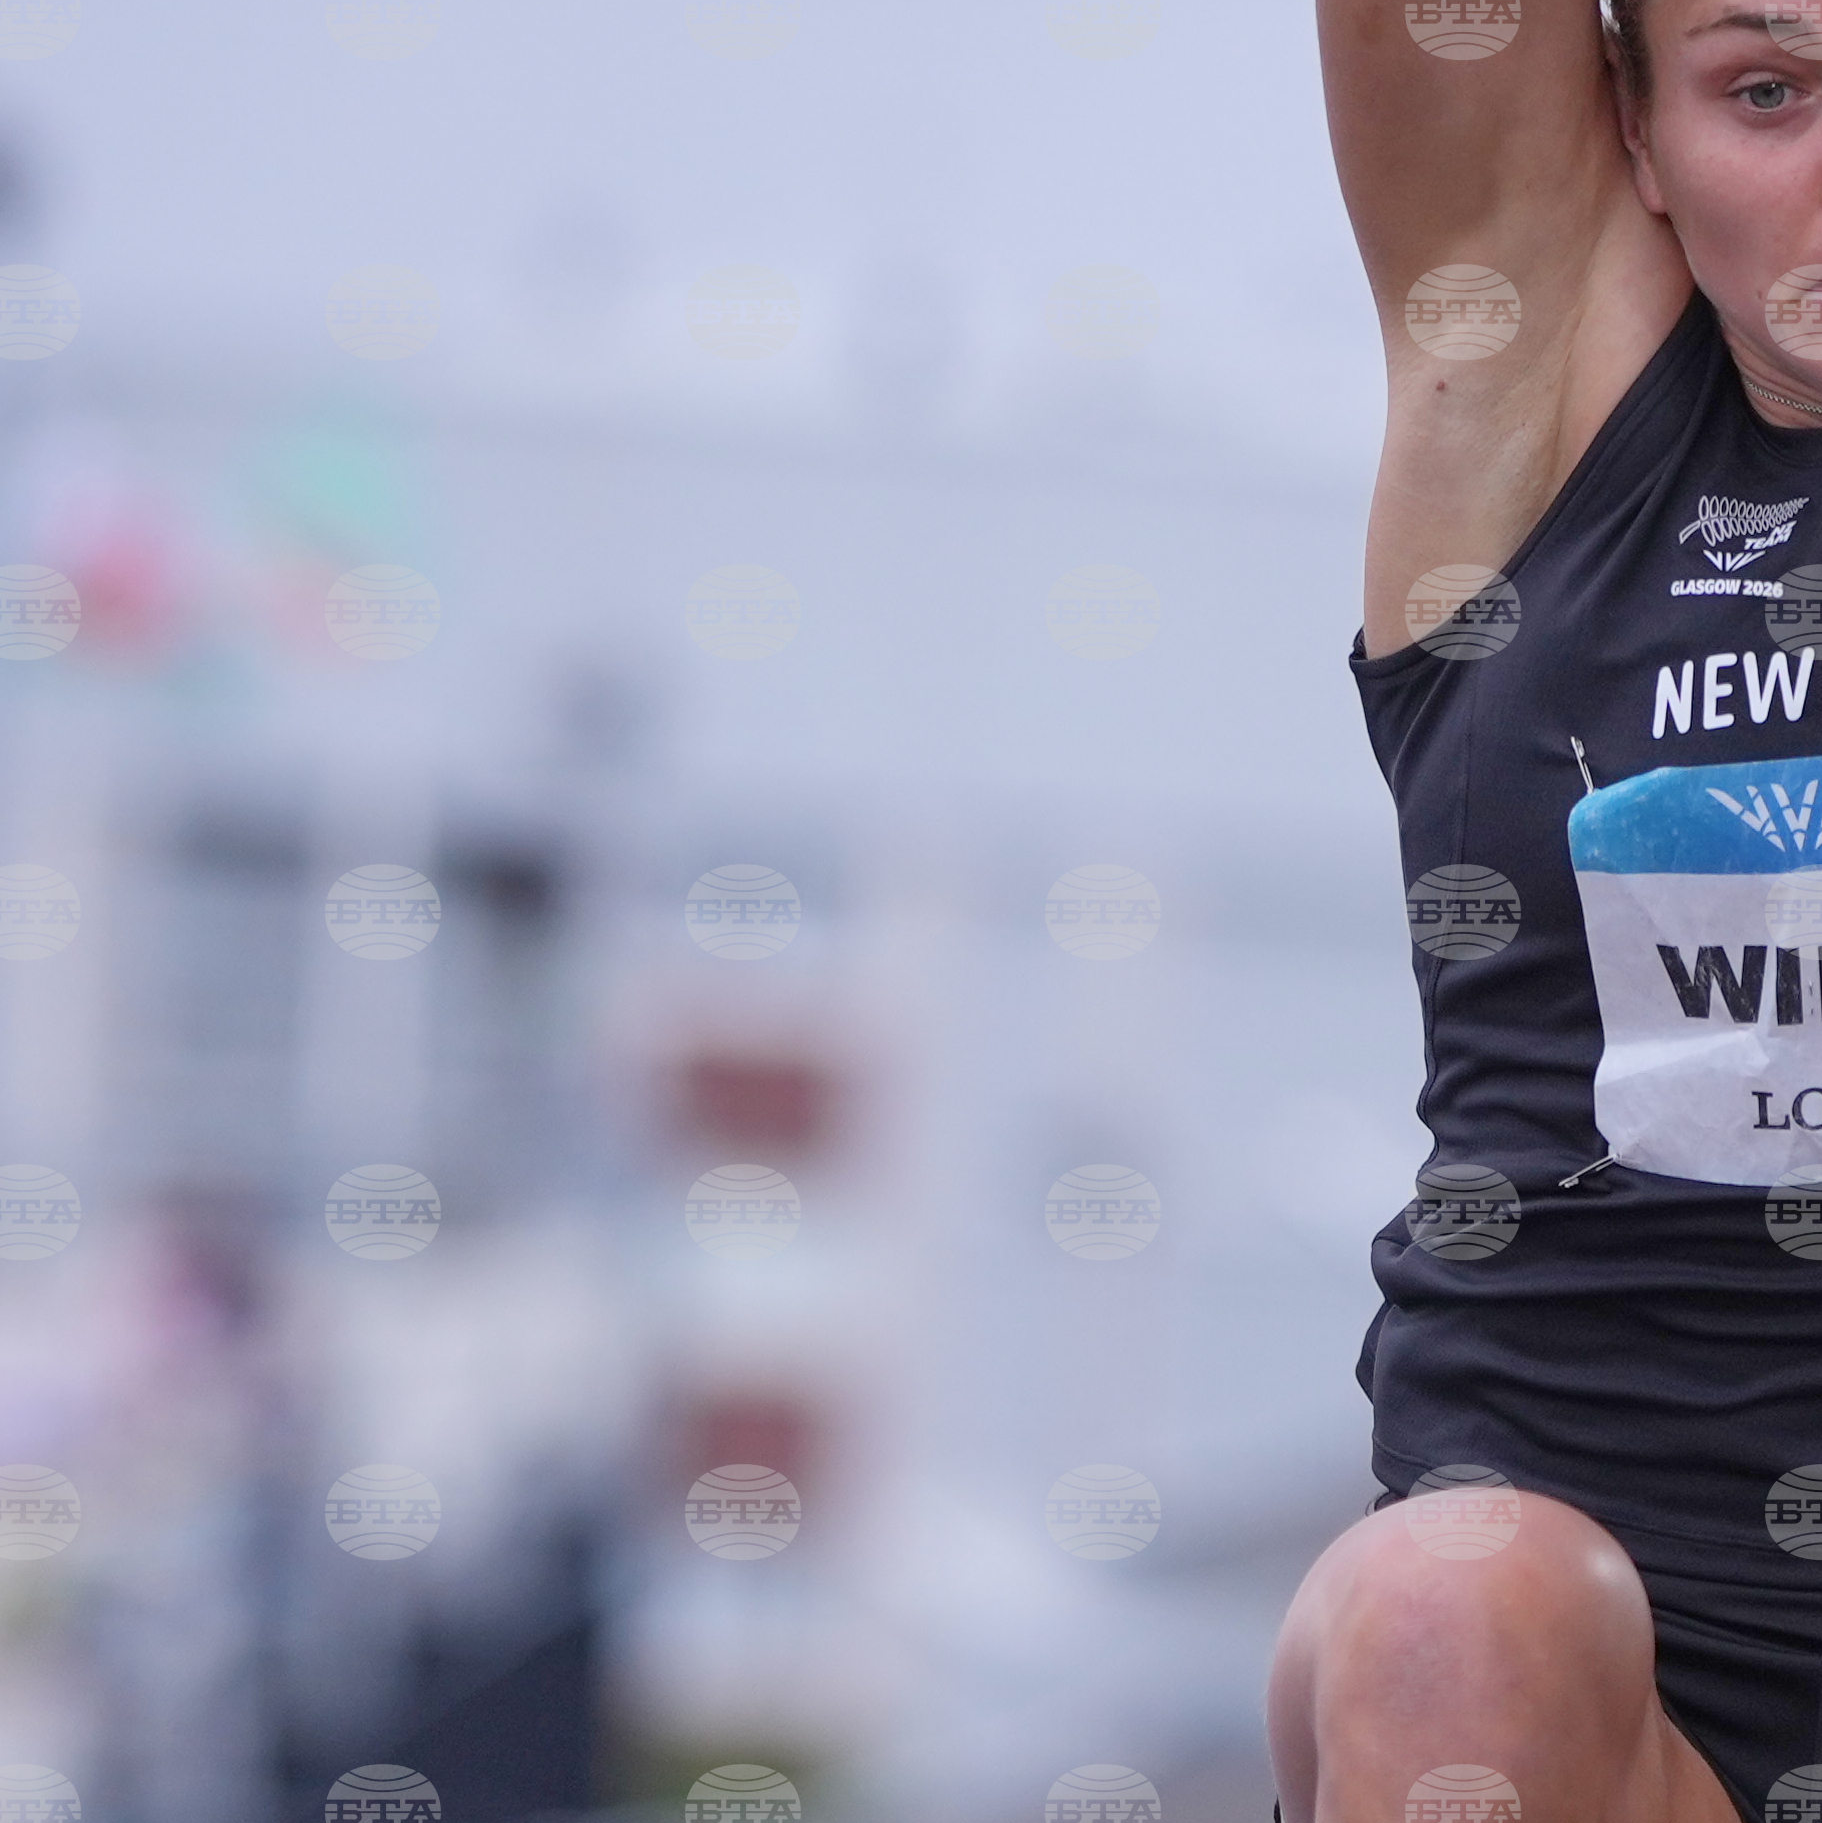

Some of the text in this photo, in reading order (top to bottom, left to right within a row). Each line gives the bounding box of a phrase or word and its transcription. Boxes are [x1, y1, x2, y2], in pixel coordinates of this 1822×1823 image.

[1744, 533, 1791, 550] TEAM
[1671, 579, 1783, 598] GLASGOW 2026
[1652, 648, 1815, 739] NEW
